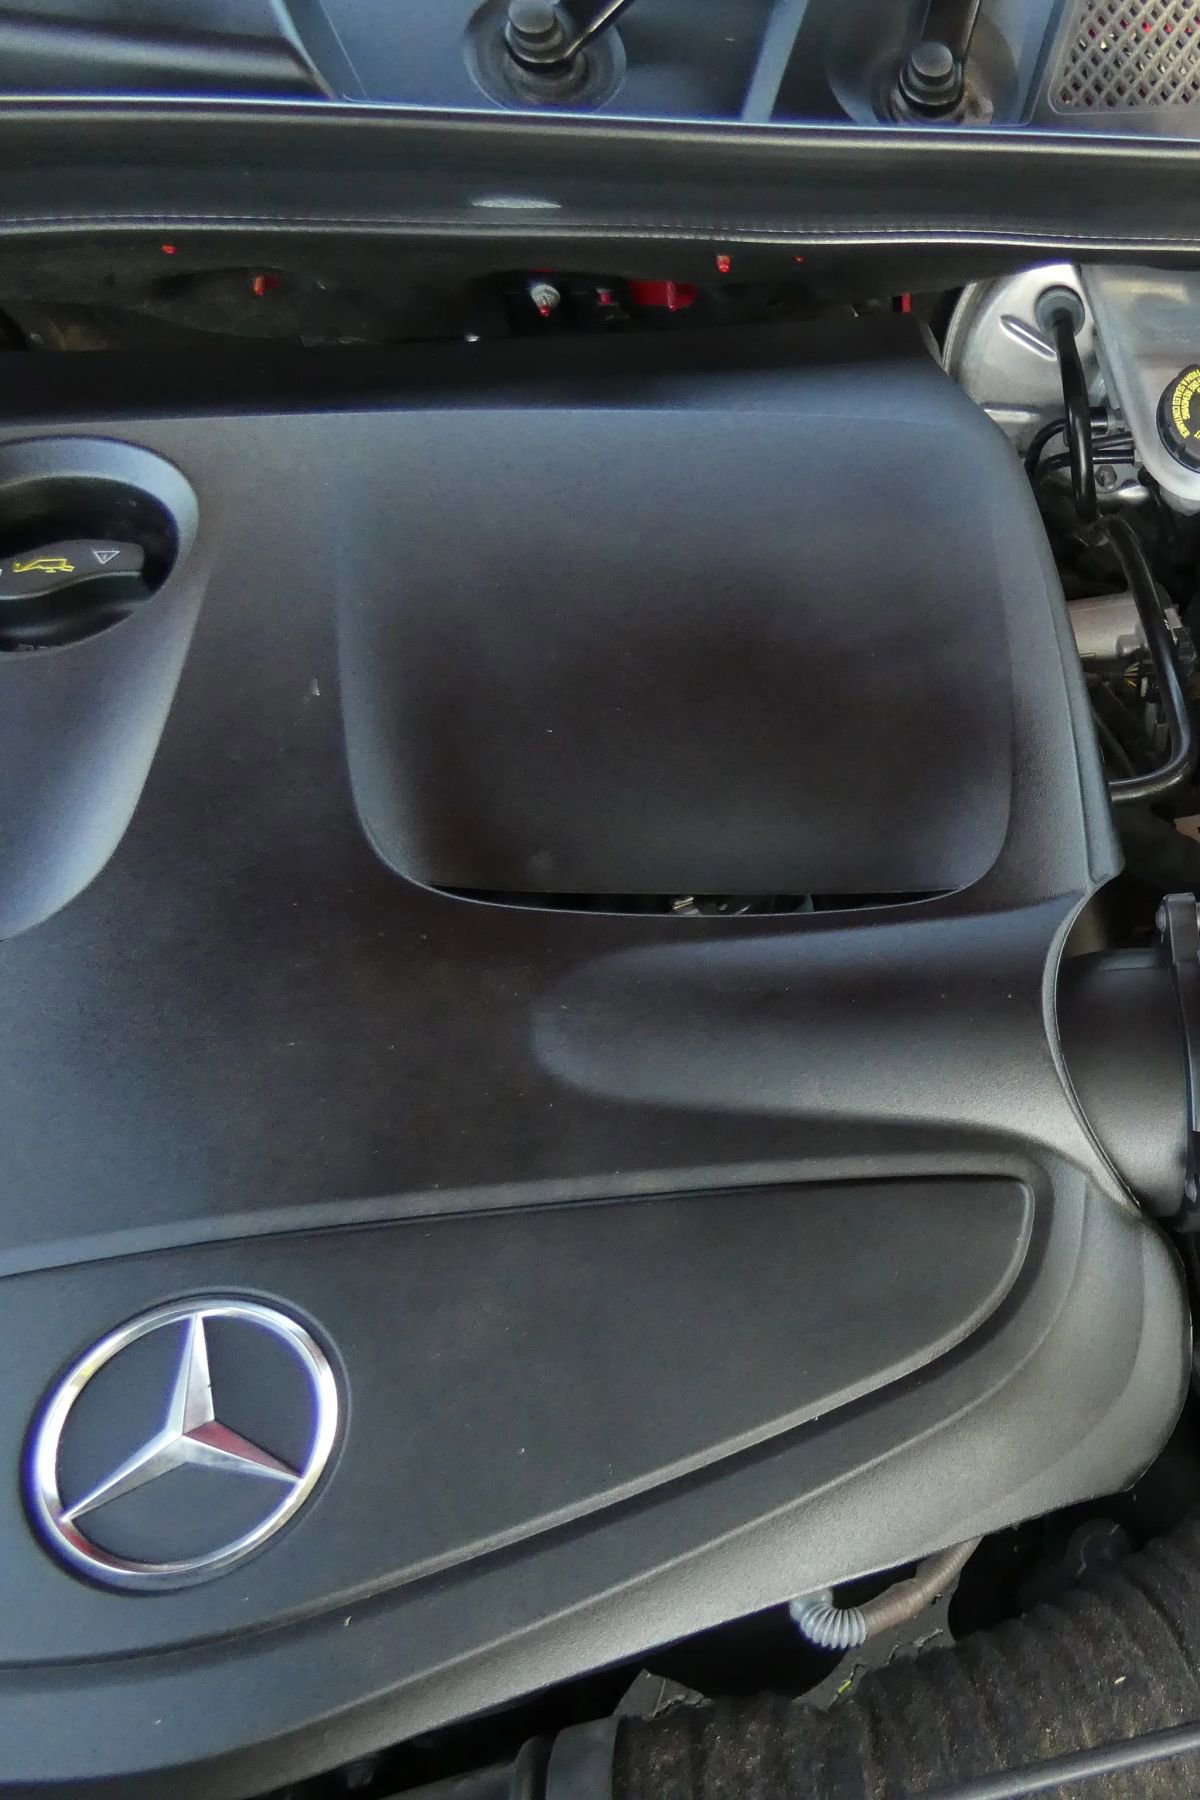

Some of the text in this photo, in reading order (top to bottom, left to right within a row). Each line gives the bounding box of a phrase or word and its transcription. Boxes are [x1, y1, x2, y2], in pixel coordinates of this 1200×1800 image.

[1186, 369, 1200, 383] FROM
[1172, 383, 1186, 406] SEALED
[1180, 388, 1193, 420] REMOVING
[1172, 405, 1190, 438] CONTAINER
